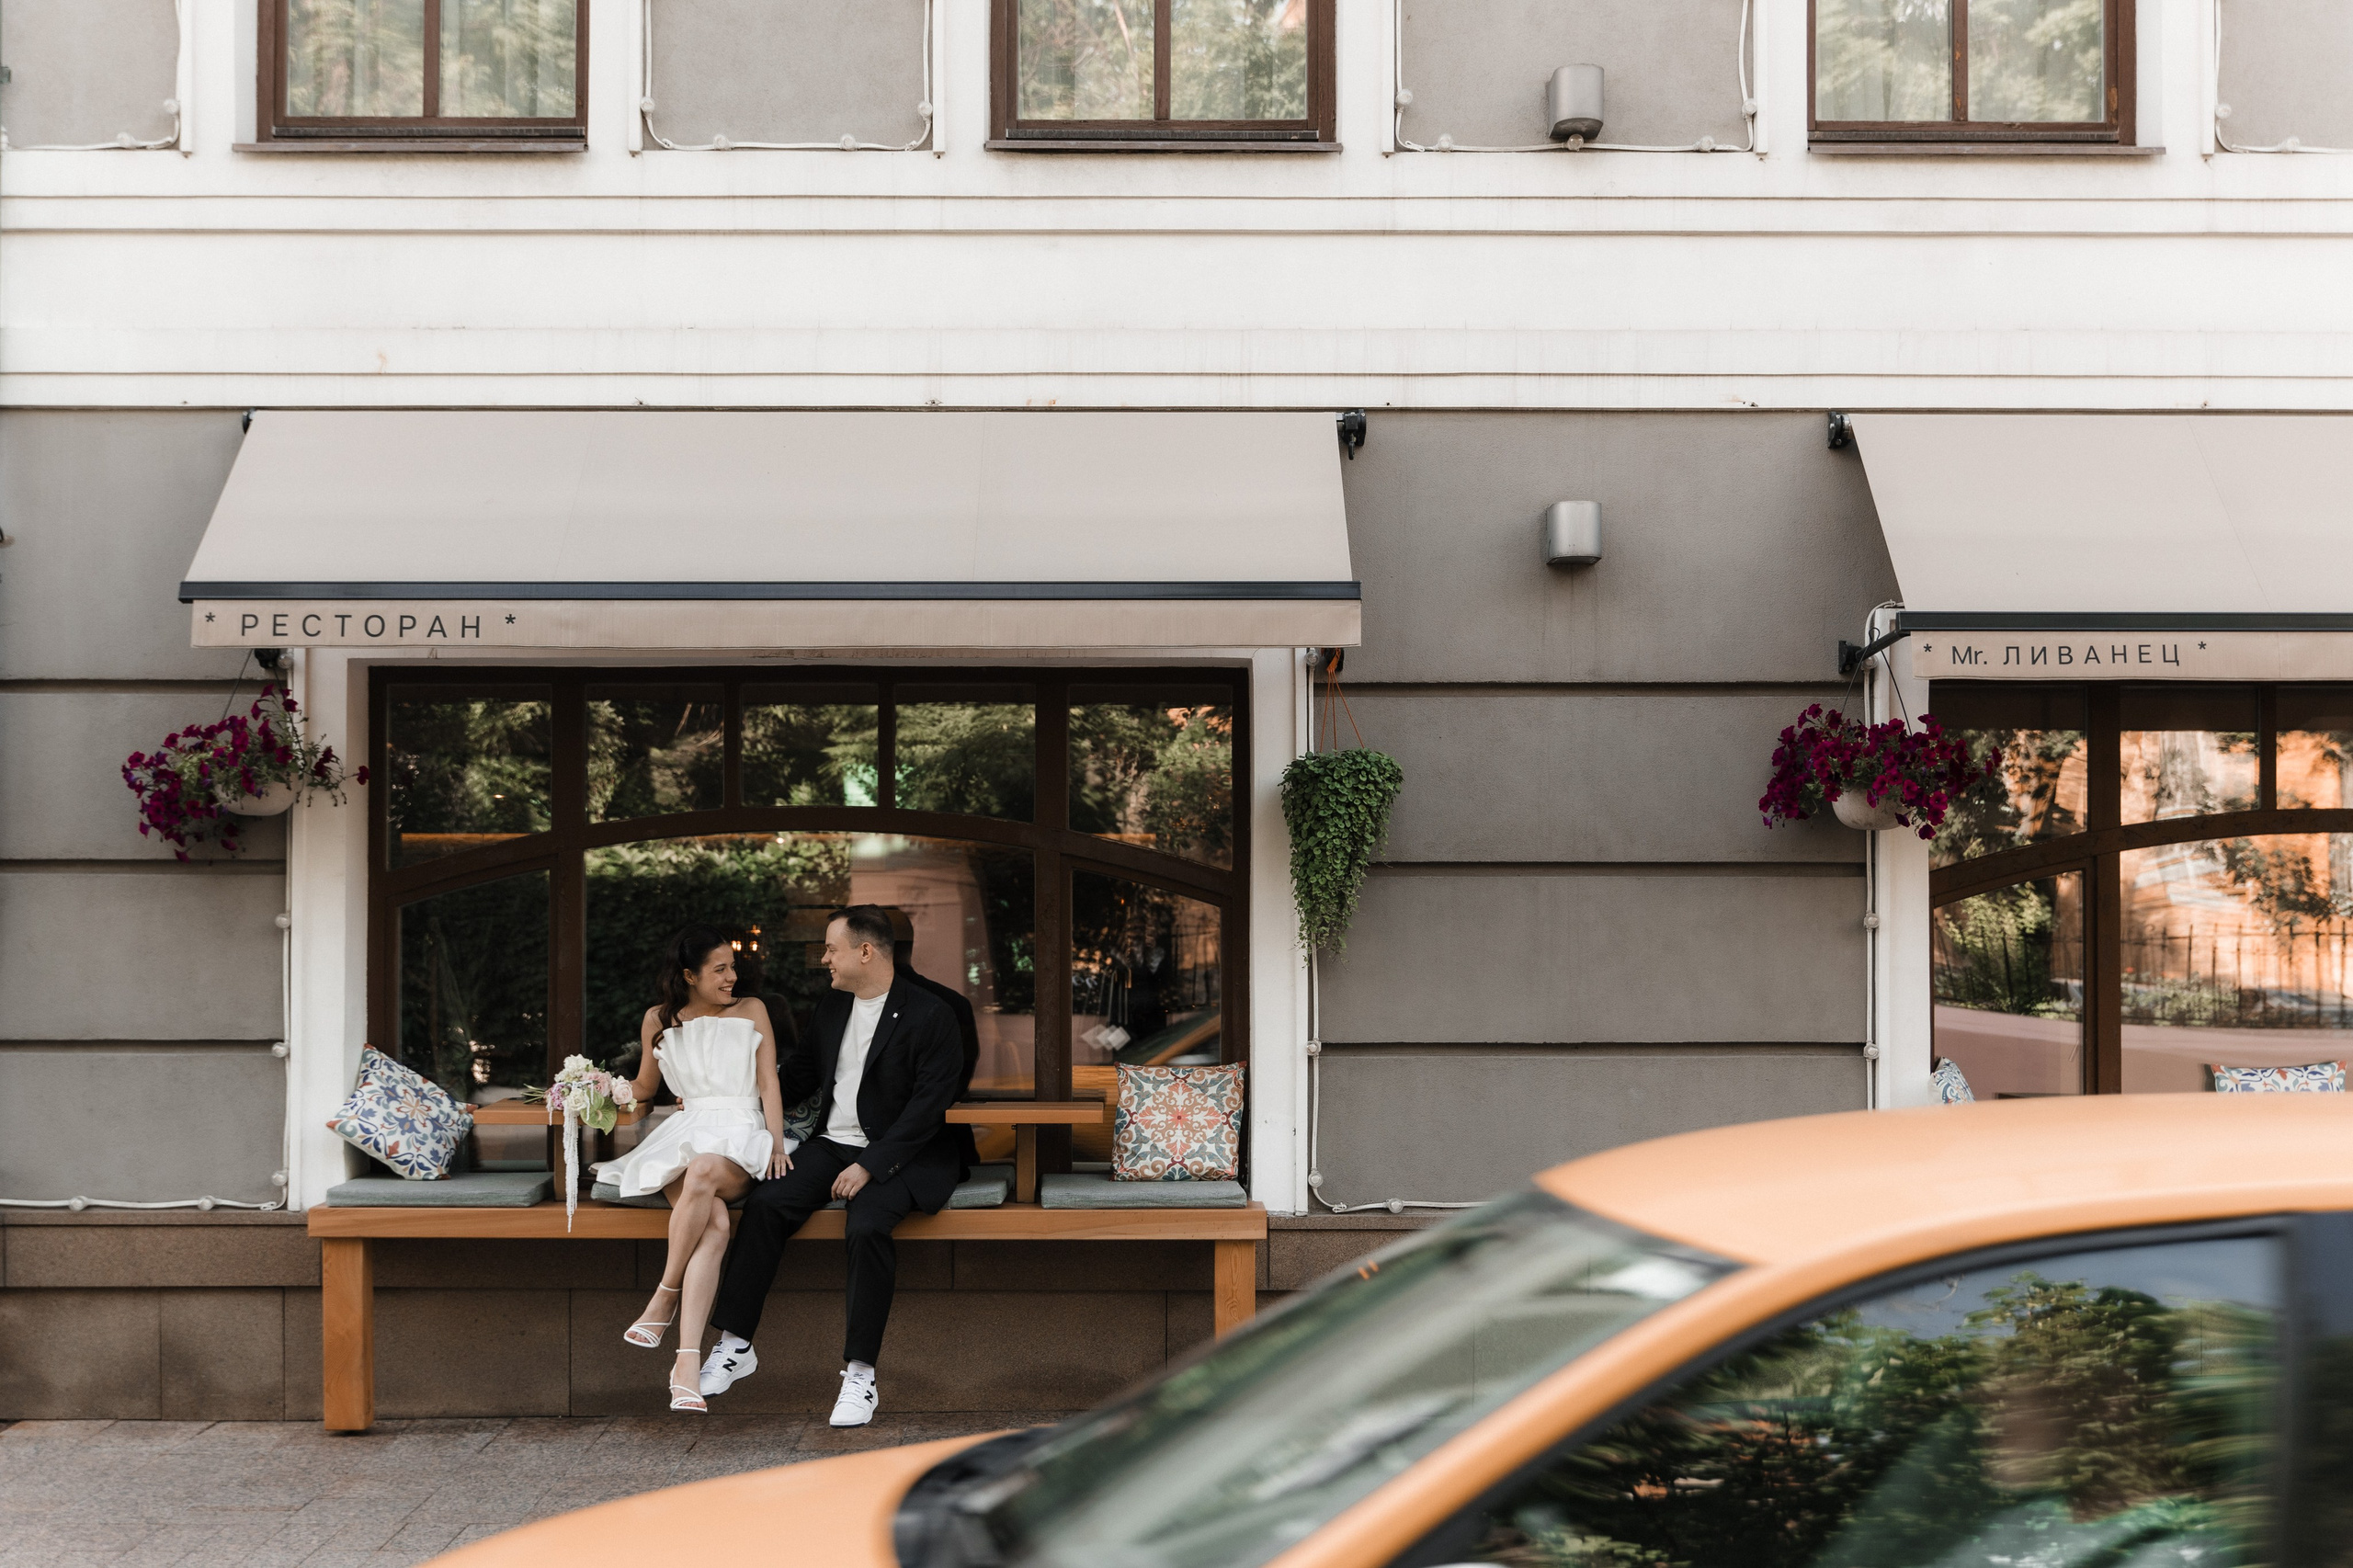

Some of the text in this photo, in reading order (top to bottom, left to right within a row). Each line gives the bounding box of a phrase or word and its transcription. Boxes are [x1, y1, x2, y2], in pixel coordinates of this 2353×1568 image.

[241, 613, 481, 639] РЕСТОРАН
[1951, 643, 2180, 666] Mr. ЛИВАНЕЦ
